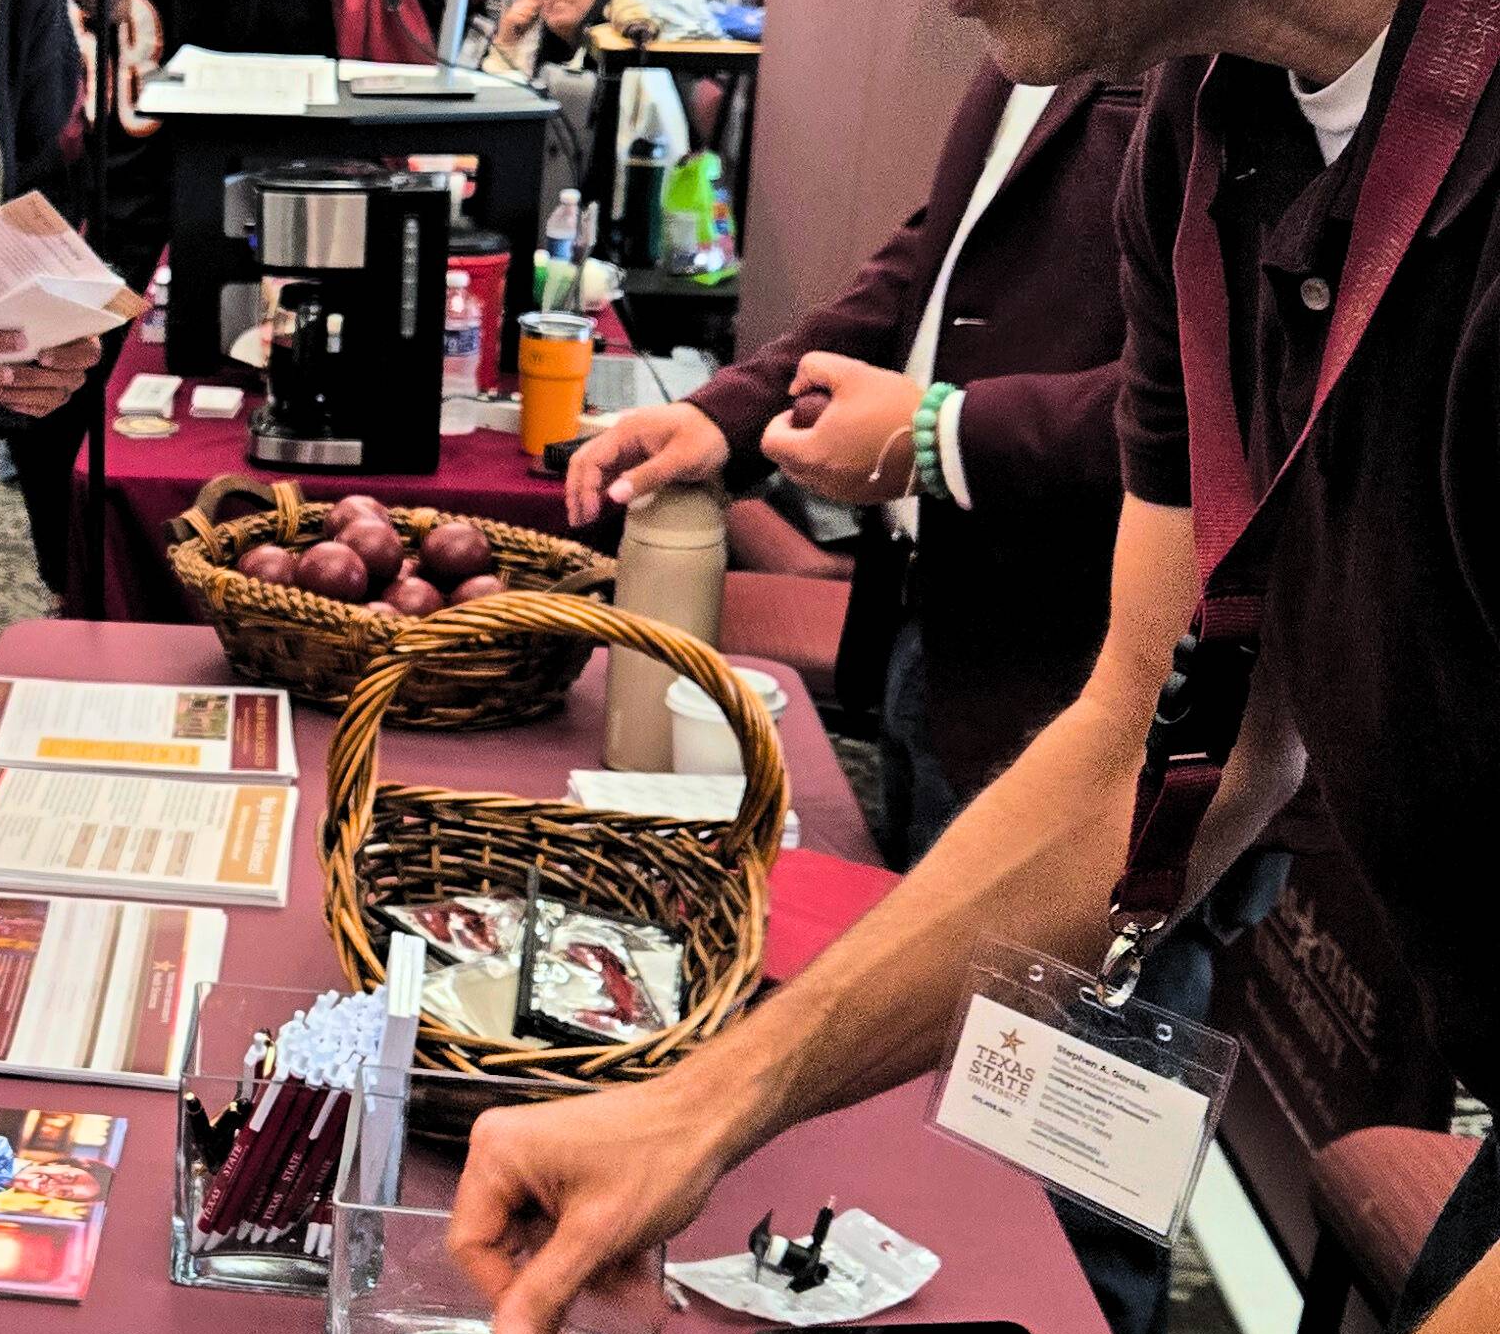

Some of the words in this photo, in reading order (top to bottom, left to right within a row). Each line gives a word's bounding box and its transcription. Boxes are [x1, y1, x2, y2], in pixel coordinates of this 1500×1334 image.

[969, 1059, 1031, 1098] STATE
[976, 1044, 1037, 1083] TEXAS
[967, 1073, 1026, 1108] UNIVERSITY
[223, 1143, 243, 1178] STATE
[281, 1152, 301, 1183] STATE
